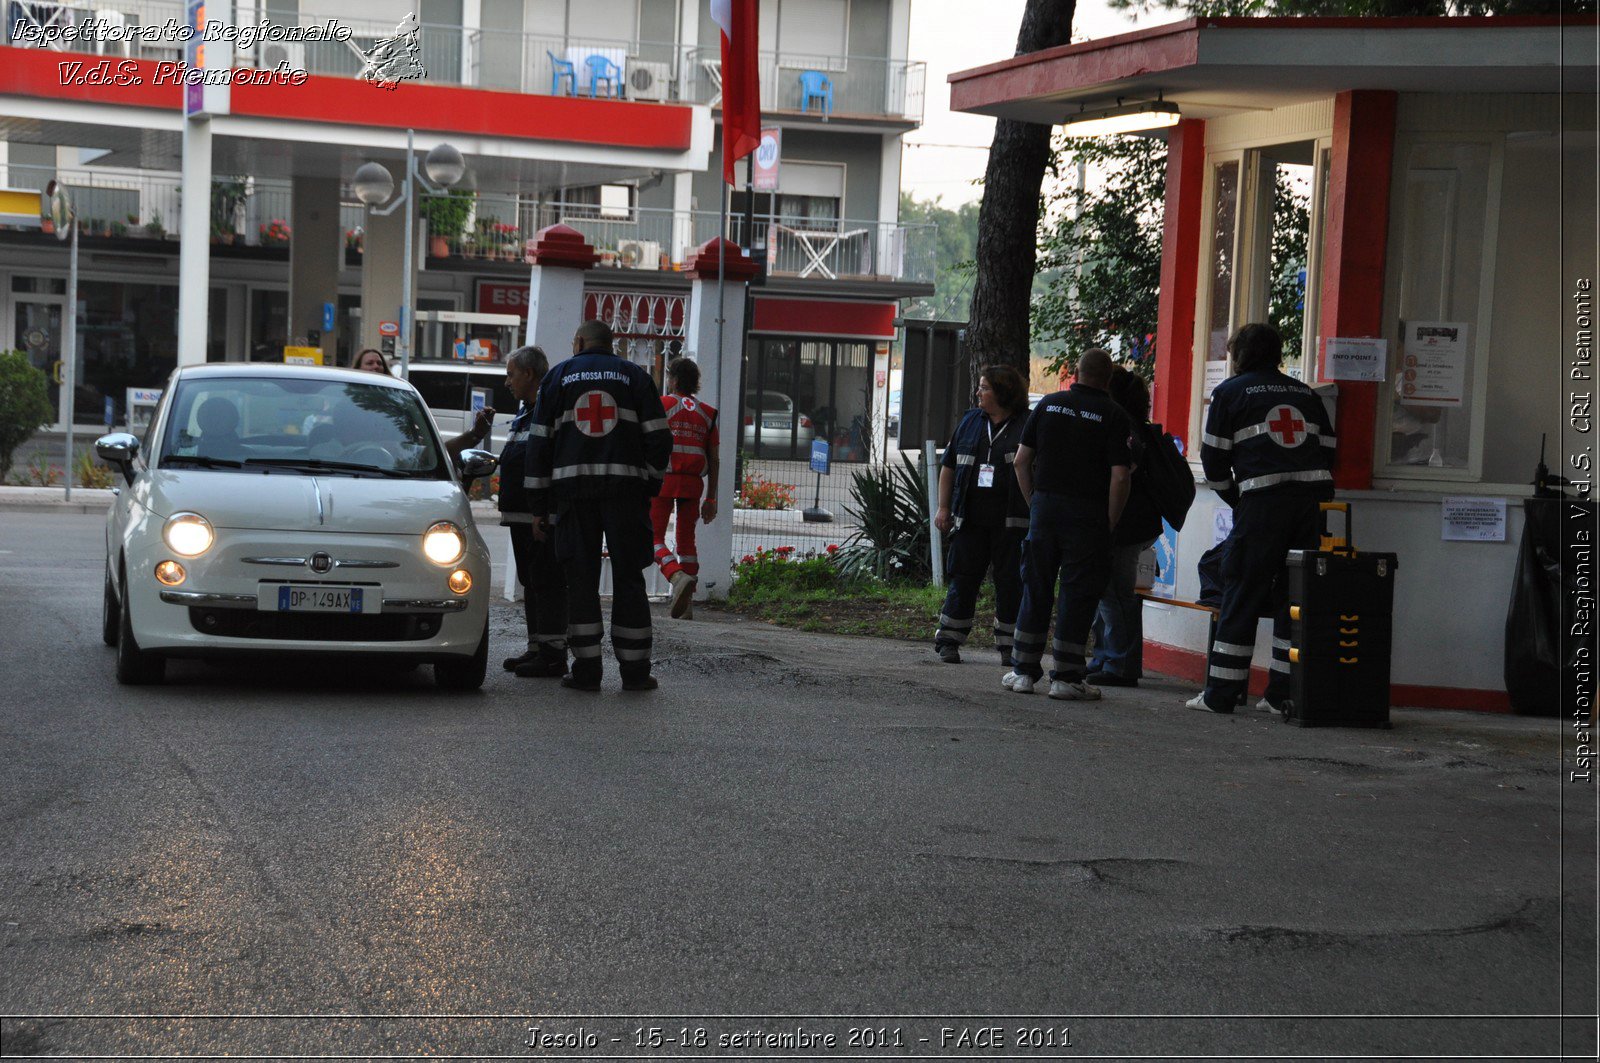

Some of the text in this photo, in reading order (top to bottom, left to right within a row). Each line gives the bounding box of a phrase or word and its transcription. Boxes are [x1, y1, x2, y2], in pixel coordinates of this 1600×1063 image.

[561, 371, 631, 386] CROCE ROSSA ITALIANA
[1245, 384, 1266, 394] CROCE
[1267, 384, 1287, 393] ROSSA
[1046, 405, 1061, 413] CROCE
